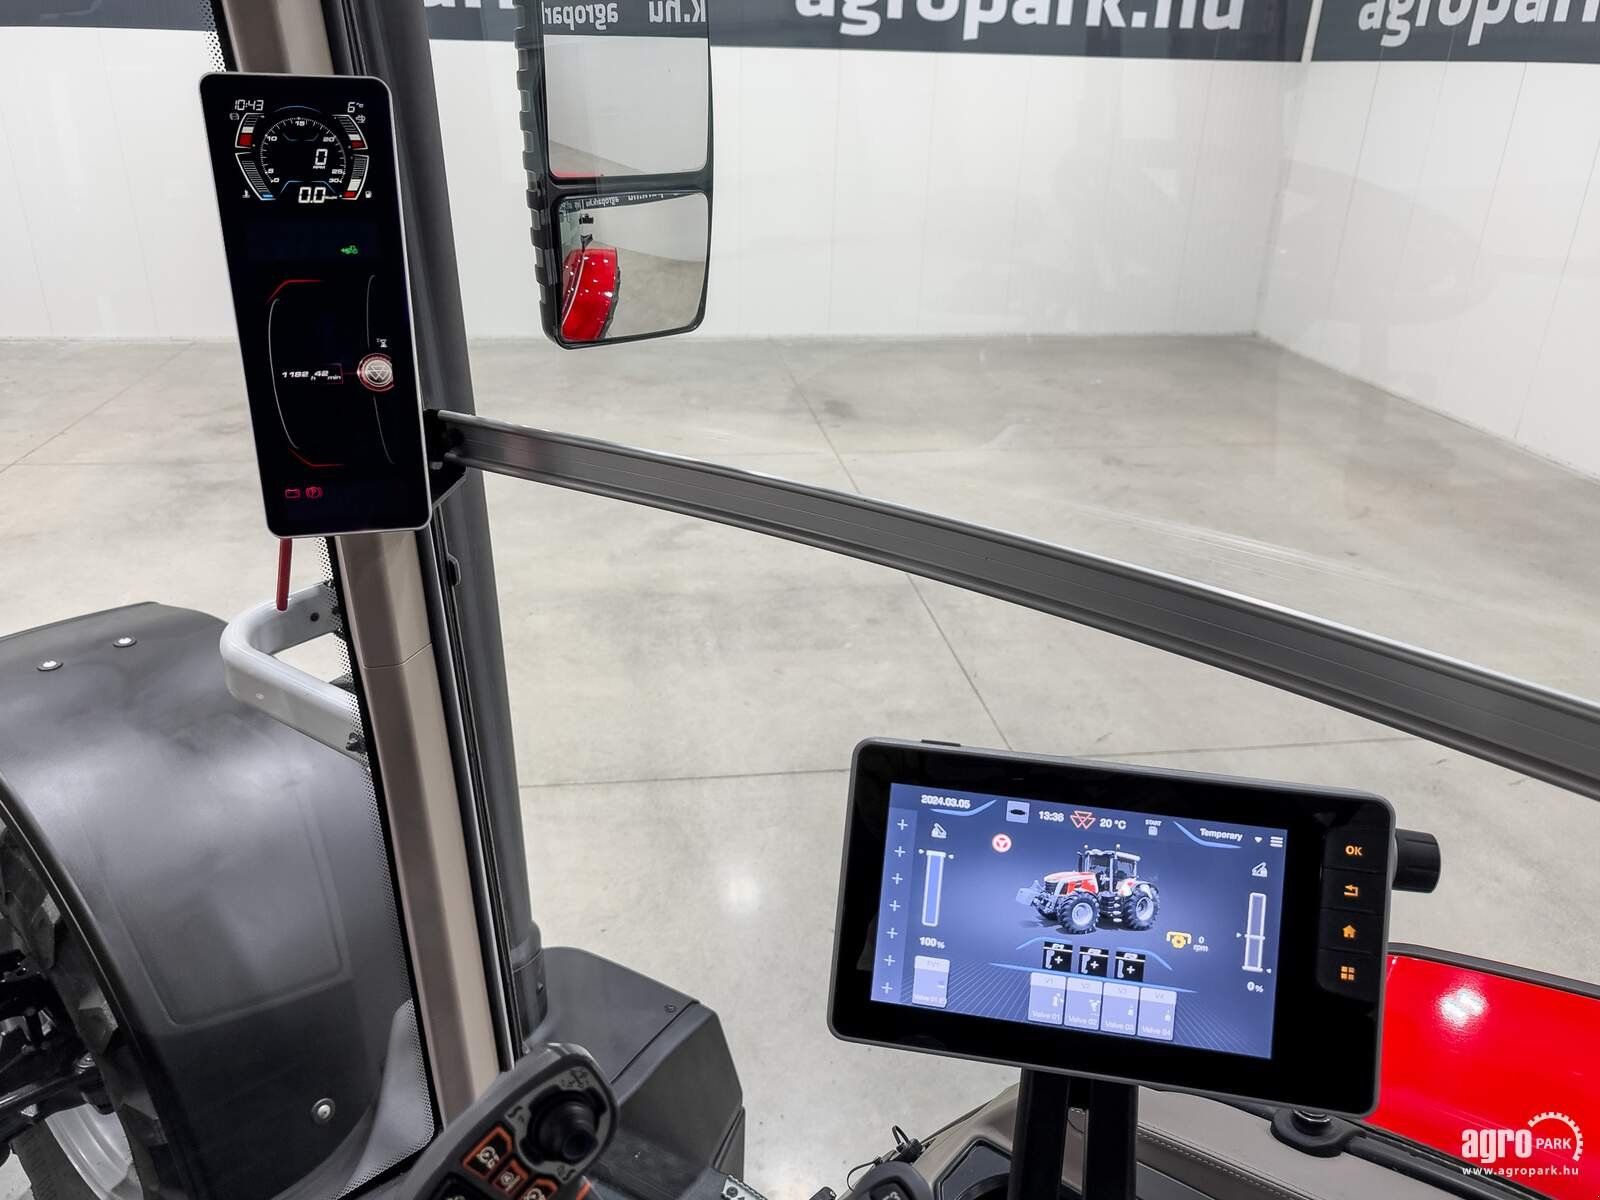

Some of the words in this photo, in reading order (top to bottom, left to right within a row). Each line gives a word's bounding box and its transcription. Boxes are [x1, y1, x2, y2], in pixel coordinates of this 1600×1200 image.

[1357, 0, 1599, 47] agropar
[234, 99, 264, 111] 10:43
[315, 148, 328, 165] 0
[298, 186, 326, 204] 0.0
[920, 794, 971, 809] 2024.03.05
[1099, 818, 1113, 829] 20
[1145, 818, 1162, 827] START
[1199, 827, 1243, 842] Temporary
[1345, 844, 1363, 857] OK
[1198, 936, 1205, 944] 0
[1193, 944, 1209, 953] rpm
